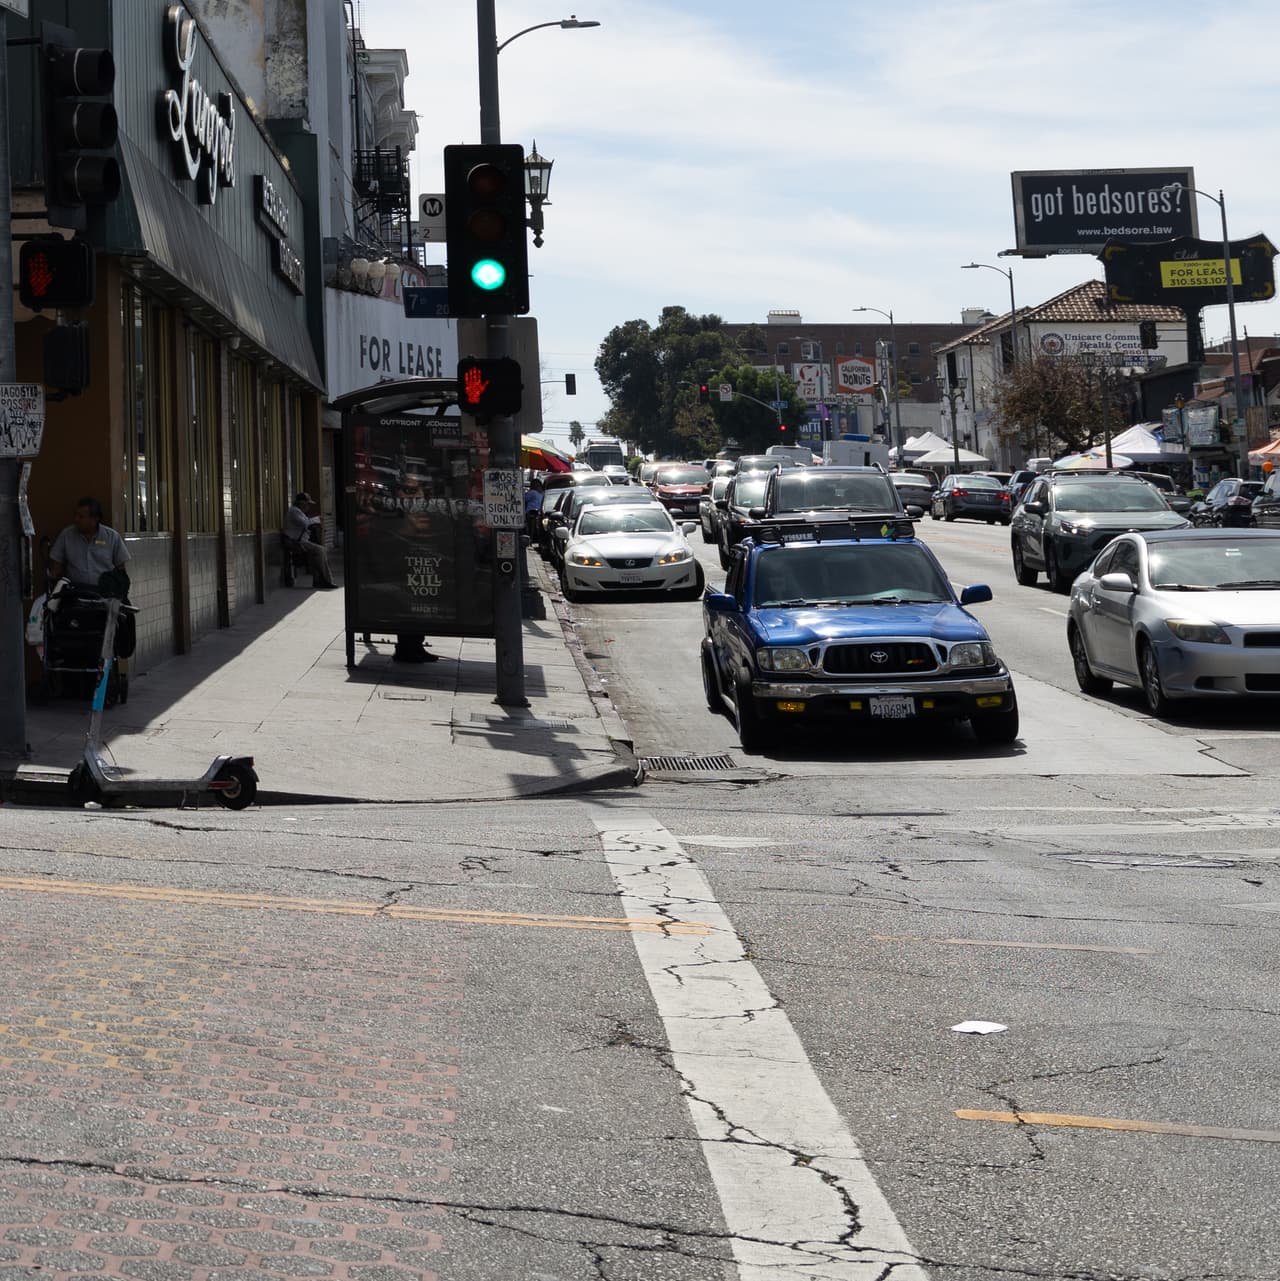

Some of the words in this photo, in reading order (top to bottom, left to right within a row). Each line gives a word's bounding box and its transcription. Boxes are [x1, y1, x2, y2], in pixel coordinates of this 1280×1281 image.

[1031, 186, 1064, 222] got
[1072, 182, 1183, 216] bedsores?
[1077, 225, 1173, 236] www.bedsore.law
[1170, 269, 1193, 277] FOR
[1197, 268, 1224, 276] LEAS
[1170, 277, 1233, 286] 310.553.107
[359, 334, 391, 372] FOR
[399, 341, 443, 377] LEASE
[843, 373, 871, 385] DONUTS
[488, 503, 521, 514] SIGNAL
[493, 514, 516, 525] ONLY
[404, 556, 442, 567] THEY
[407, 574, 442, 586] KILL
[411, 586, 439, 596] YOU
